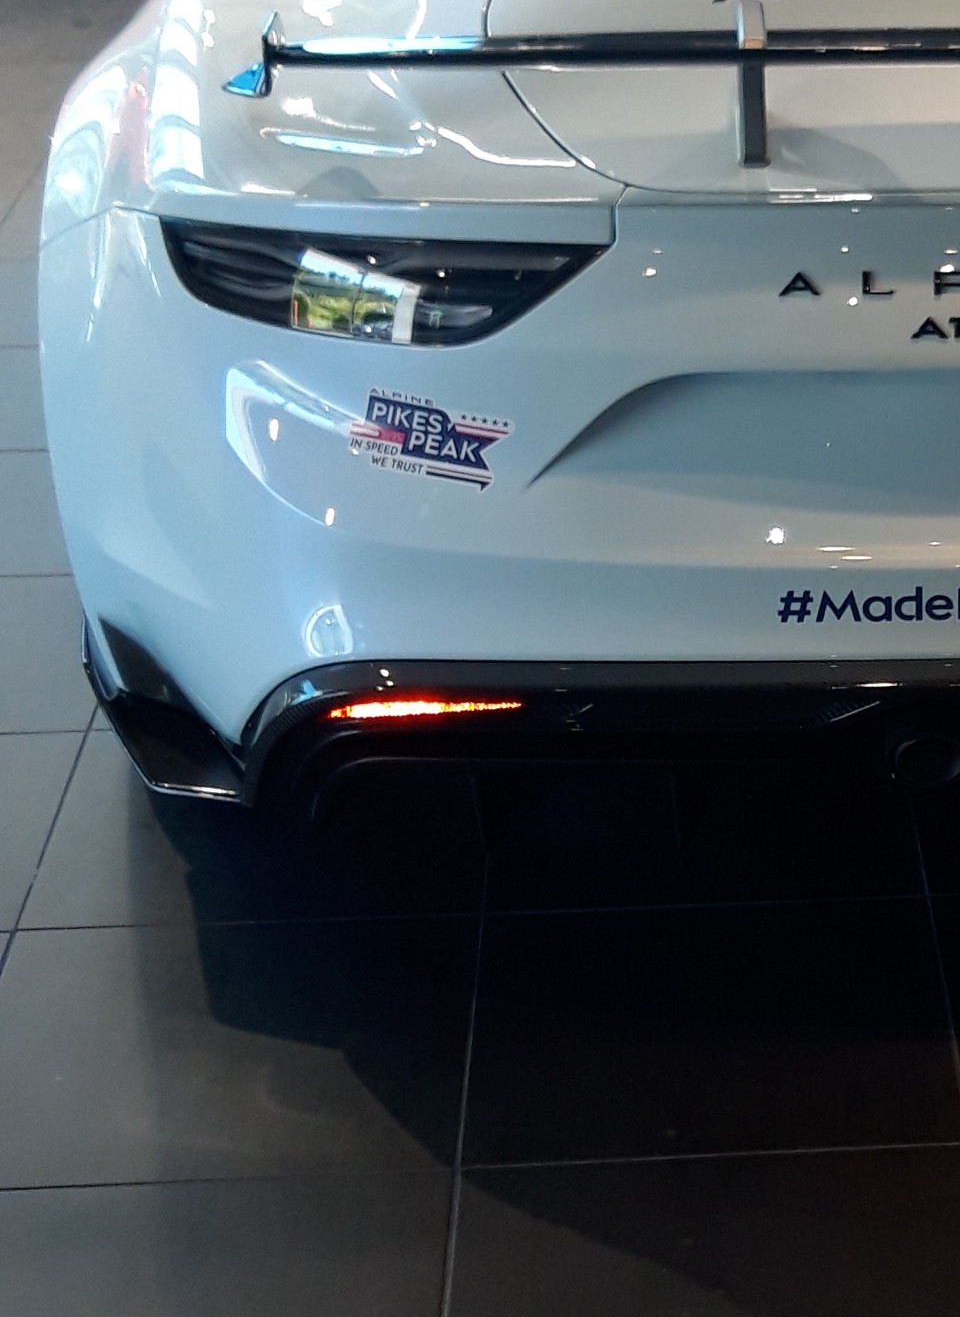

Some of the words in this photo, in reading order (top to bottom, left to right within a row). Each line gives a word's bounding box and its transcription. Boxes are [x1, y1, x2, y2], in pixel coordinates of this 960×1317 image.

[369, 388, 435, 407] ALPINE
[371, 401, 443, 434] PIKES
[350, 438, 363, 449] IN
[366, 441, 399, 456] SPEED
[408, 431, 480, 463] PEAK
[371, 454, 388, 469] WE
[391, 458, 425, 476] TRUST
